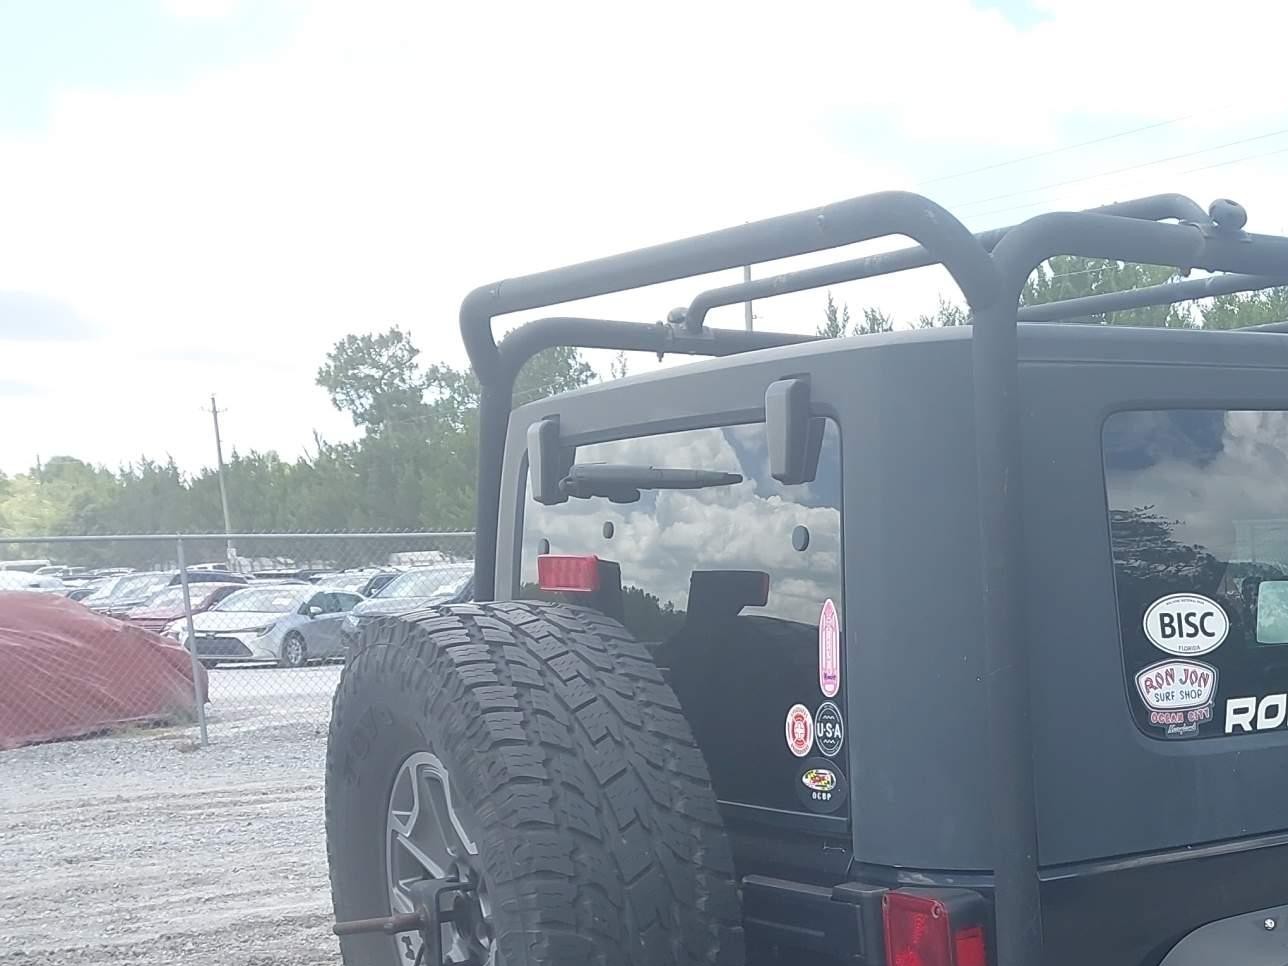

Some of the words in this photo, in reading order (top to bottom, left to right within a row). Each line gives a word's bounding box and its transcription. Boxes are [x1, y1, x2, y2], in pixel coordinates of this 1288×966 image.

[1158, 611, 1216, 638] BISC
[1144, 668, 1175, 695] RON
[1179, 668, 1210, 688] JON
[1154, 691, 1176, 702] SURF
[1180, 688, 1203, 700] SHOP
[1151, 711, 1185, 724] OCEAN
[1187, 707, 1210, 722] CITY
